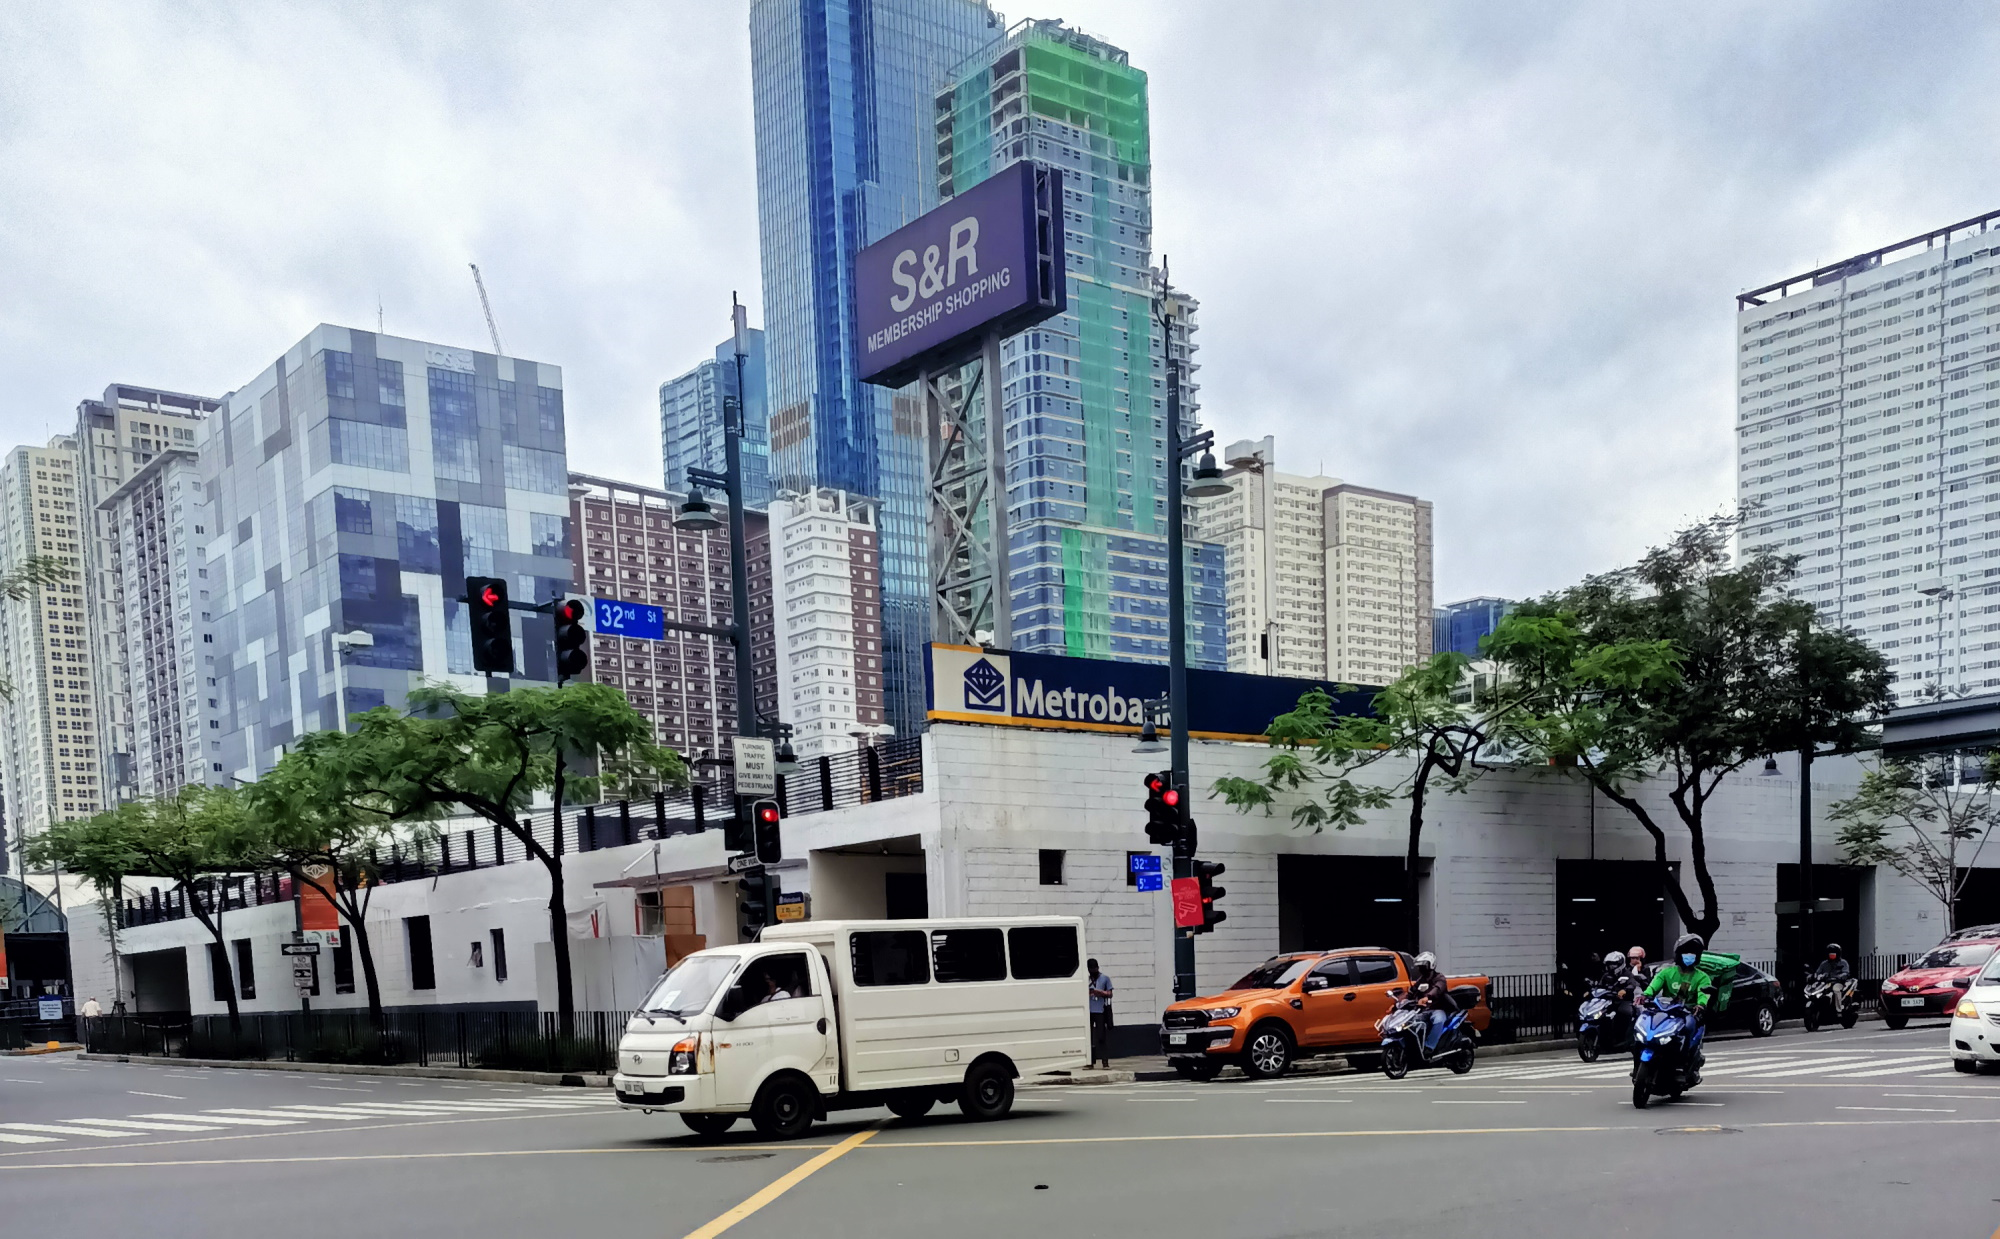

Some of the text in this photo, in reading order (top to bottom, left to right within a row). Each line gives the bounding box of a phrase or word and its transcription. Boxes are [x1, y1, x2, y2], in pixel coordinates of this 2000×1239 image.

[889, 216, 980, 313] S&R
[867, 267, 1011, 354] MEMBERSHIP SHOPPING
[601, 603, 657, 629] 32nd St
[742, 743, 765, 751] TURNING
[743, 752, 766, 760] TRAFFIC
[745, 762, 765, 770] MUST
[737, 781, 774, 790] PEDESTRIANS
[736, 860, 748, 868] ONE
